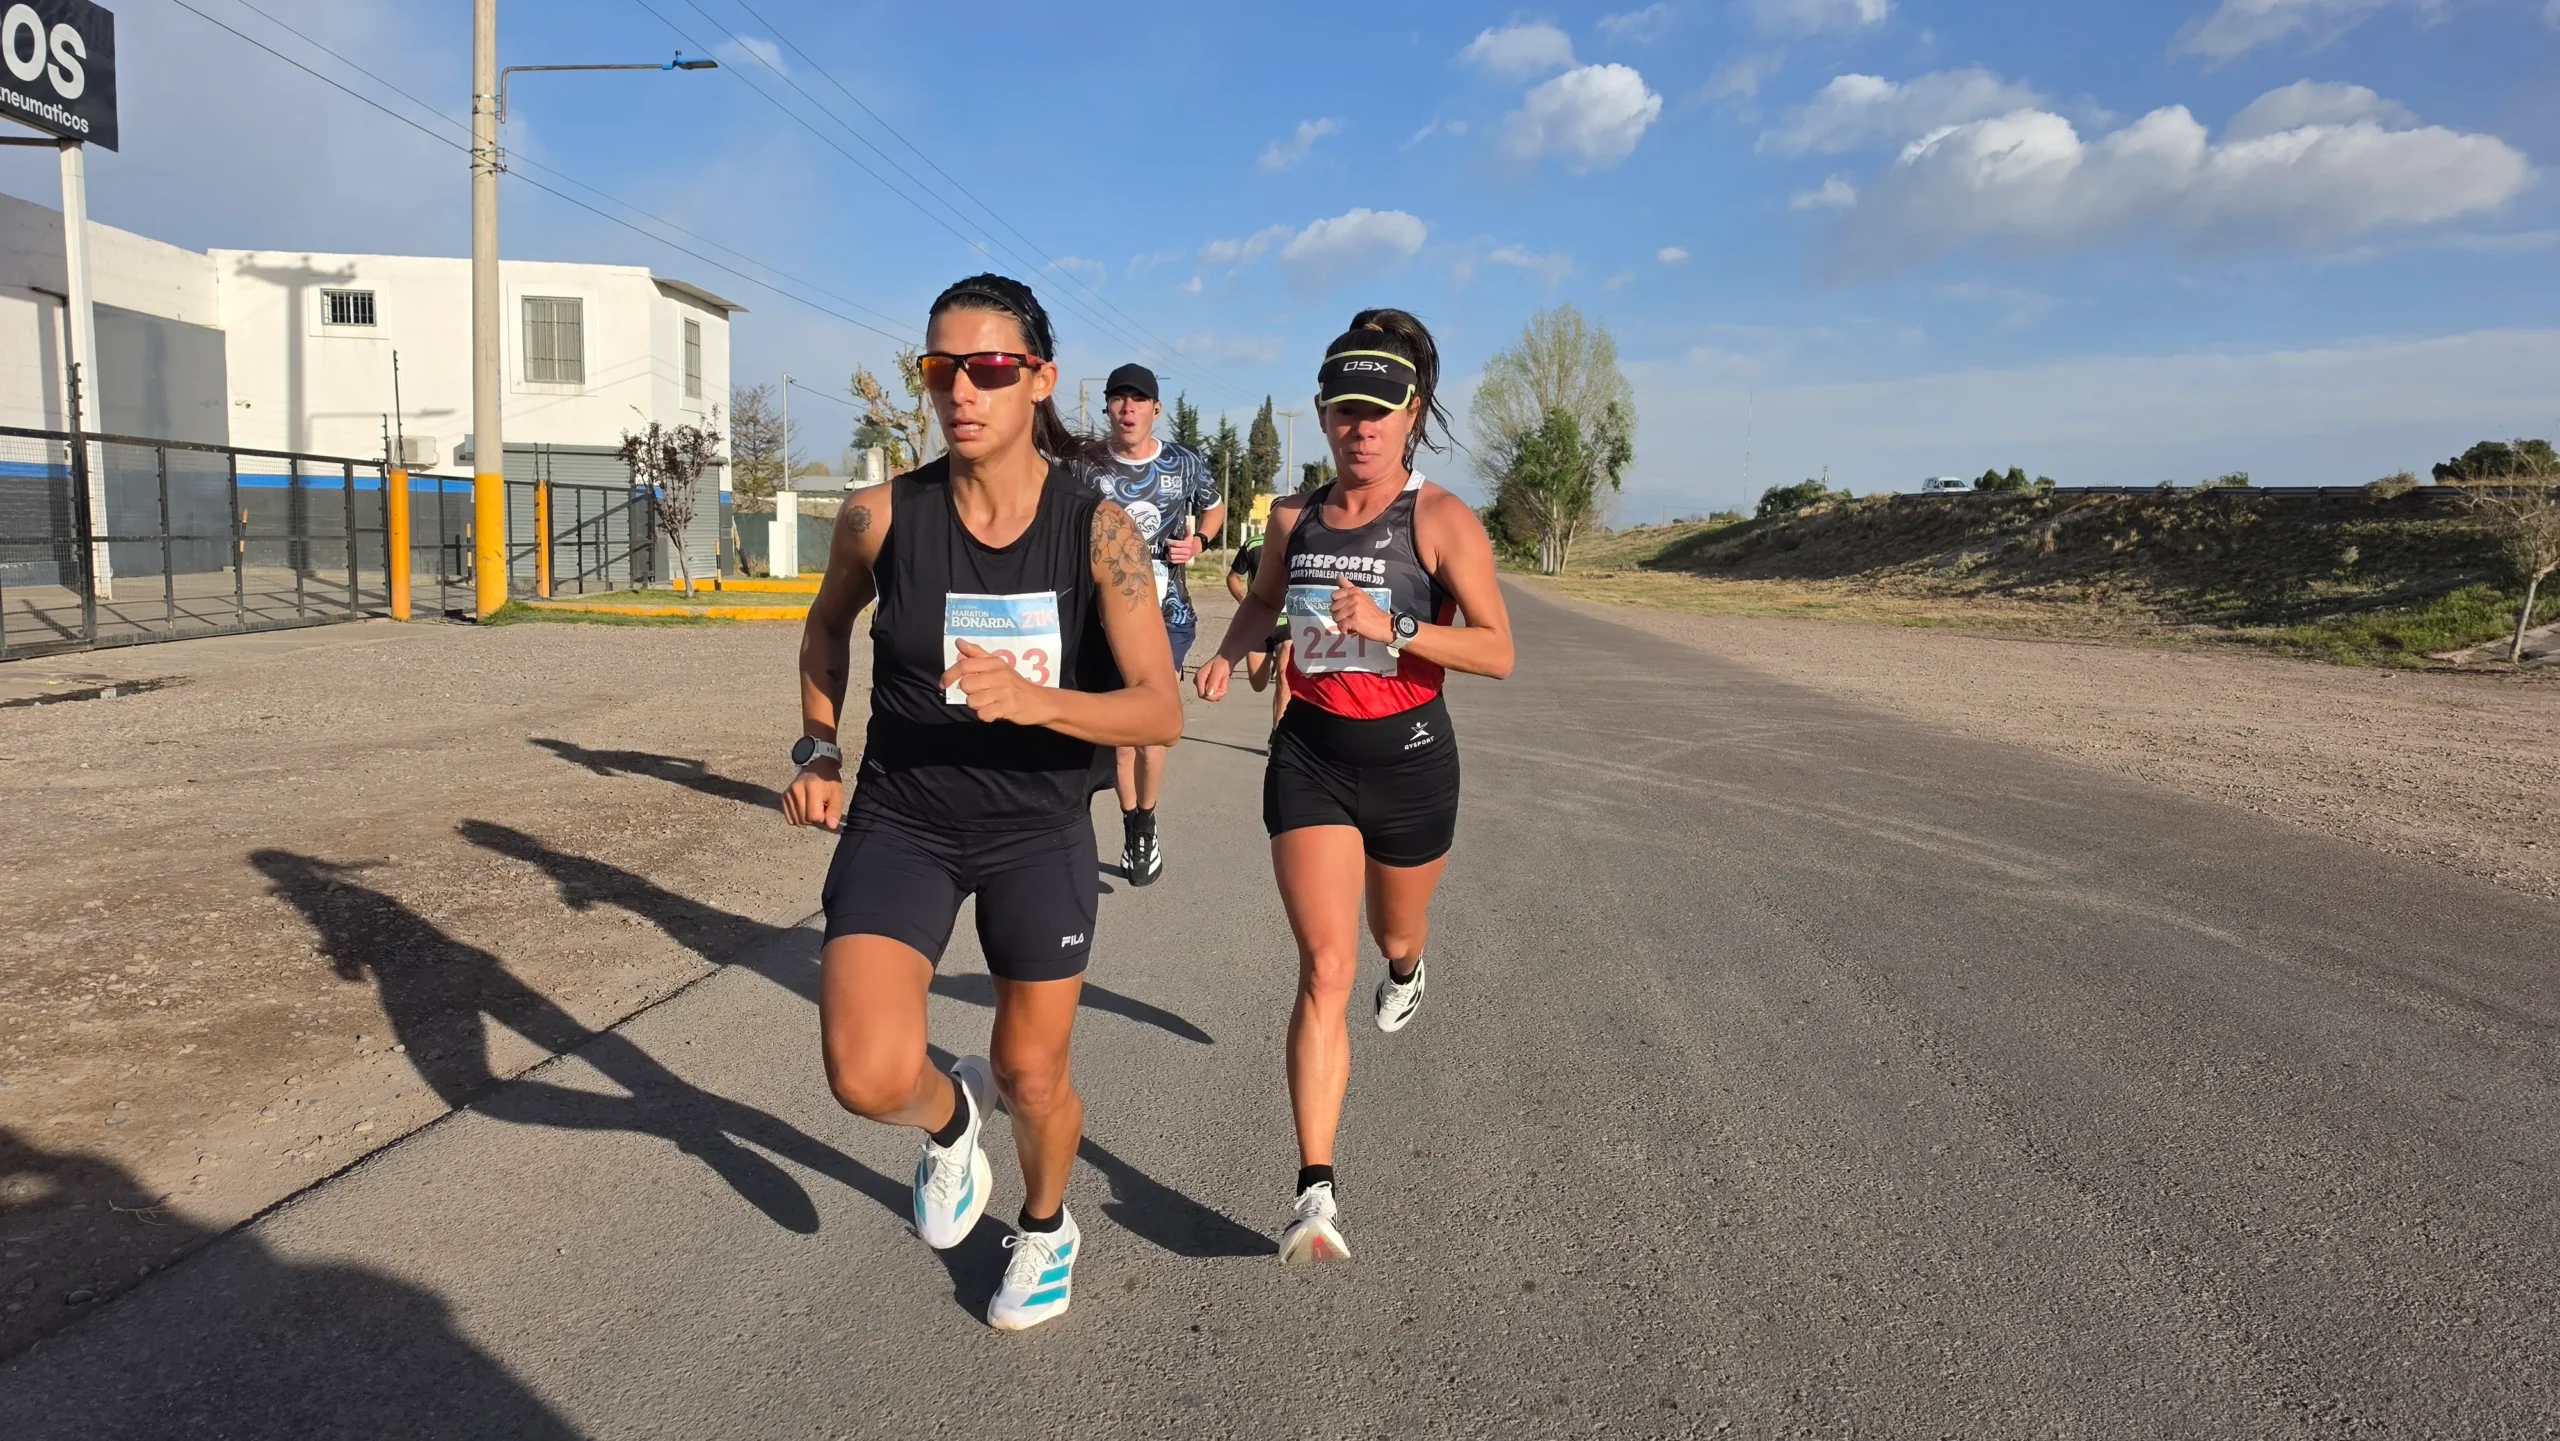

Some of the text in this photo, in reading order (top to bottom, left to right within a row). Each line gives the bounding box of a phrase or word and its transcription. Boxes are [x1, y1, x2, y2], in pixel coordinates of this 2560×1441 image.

[0, 85, 89, 133] neumaticos
[951, 617, 1016, 629] BONARDA
[1061, 932, 1085, 948] FILA
